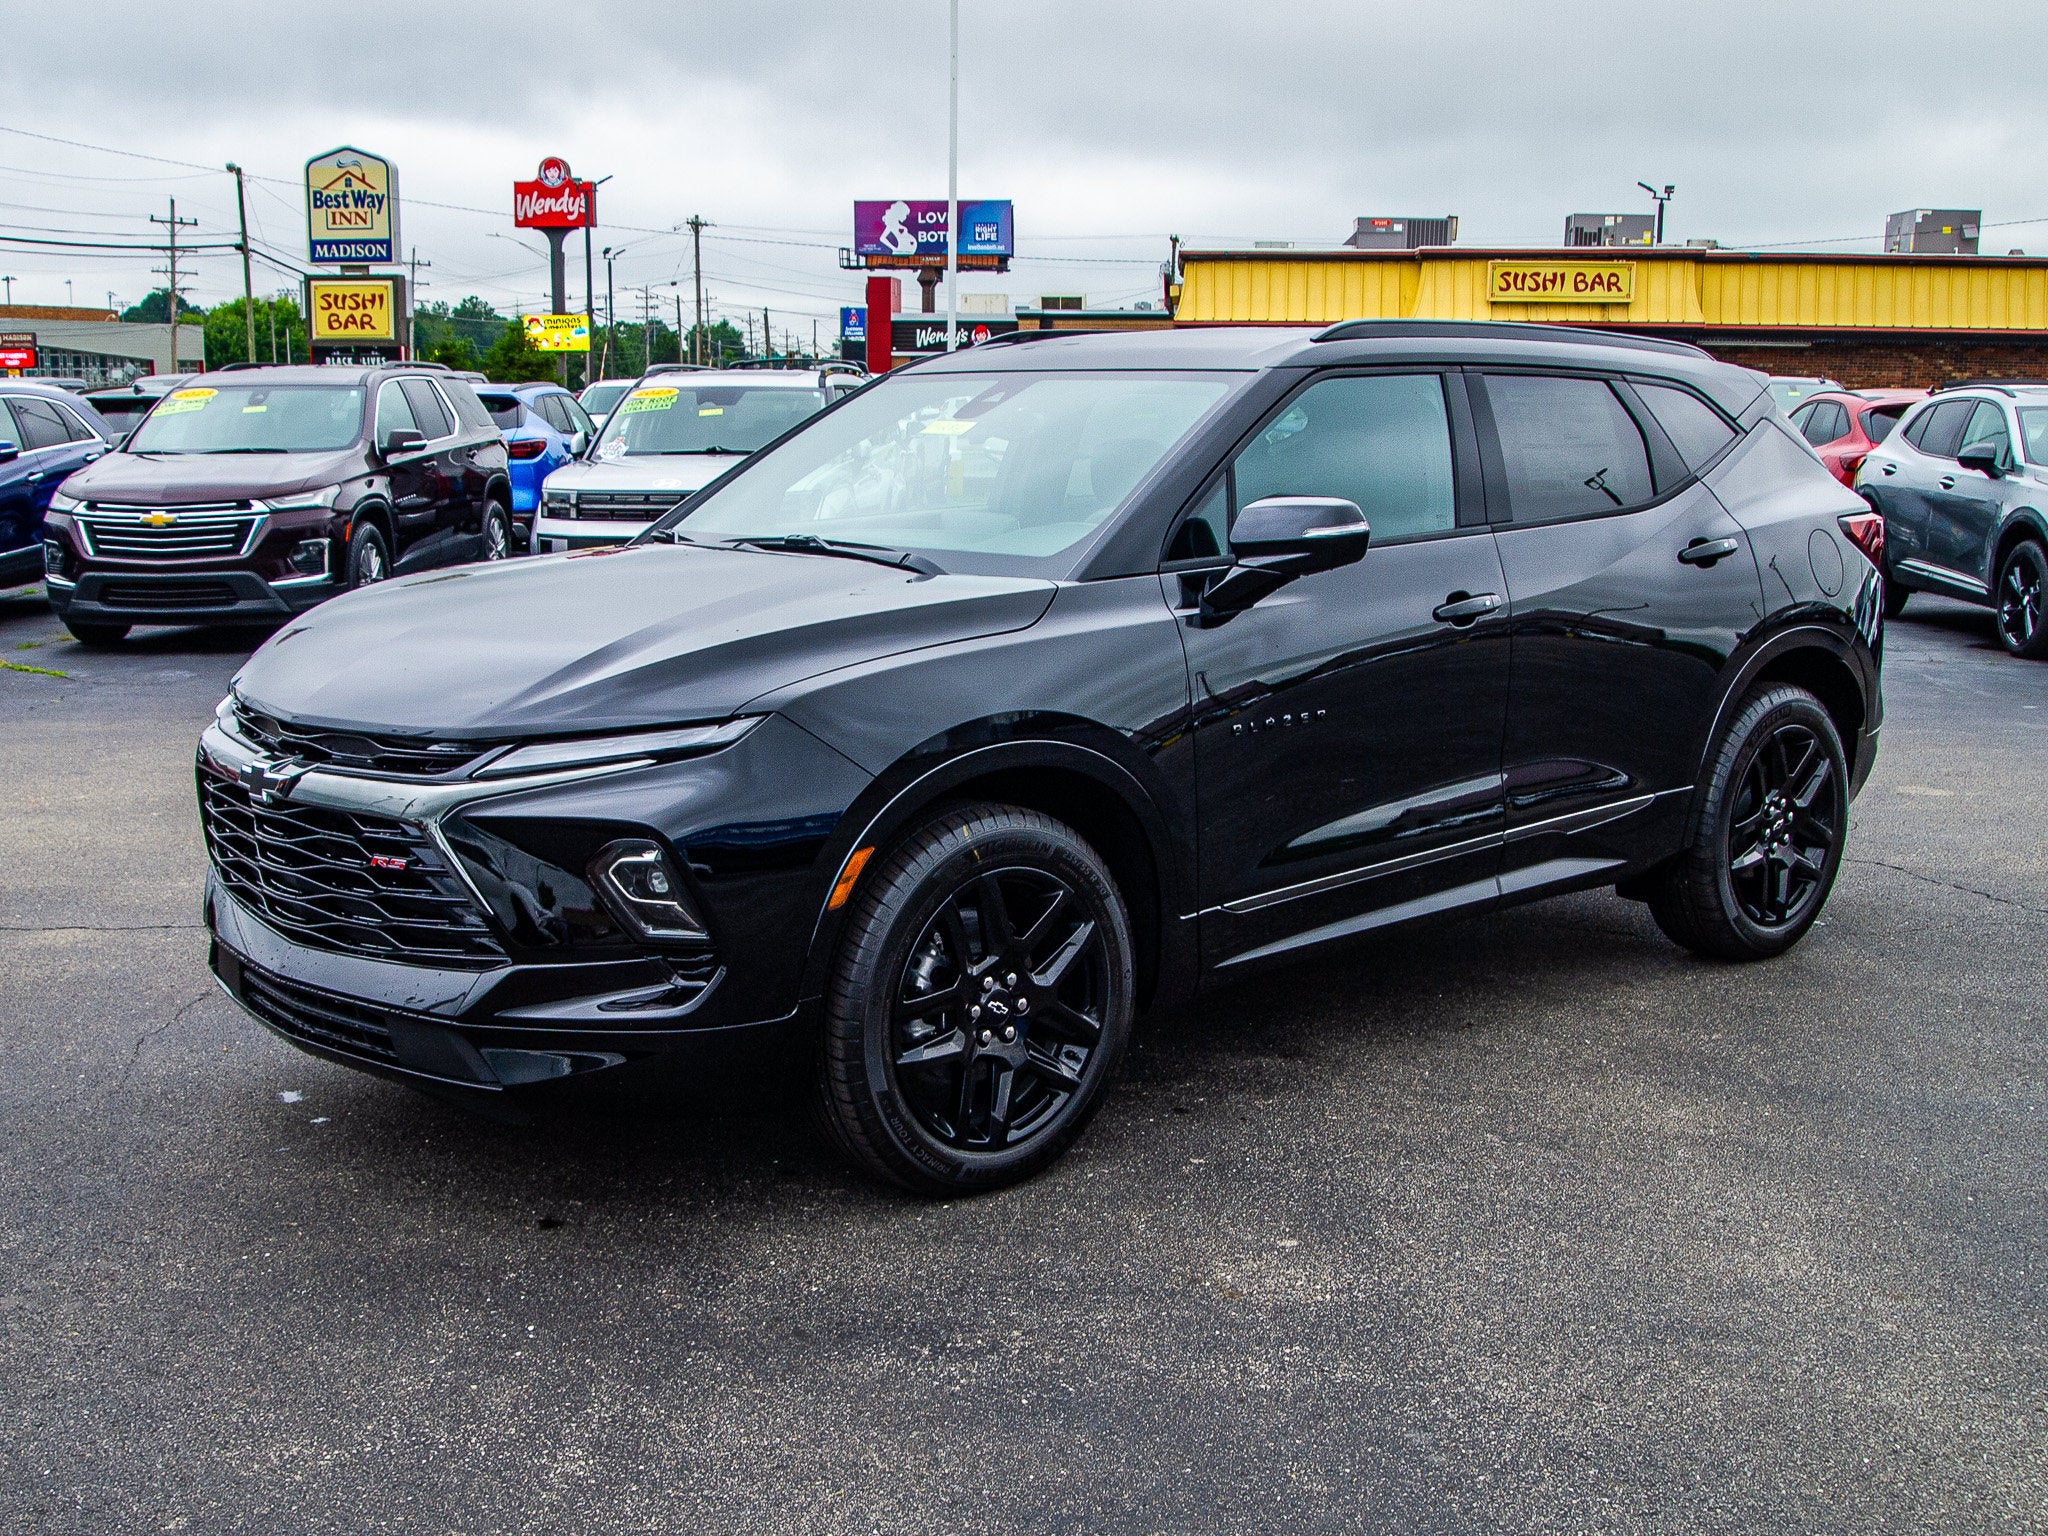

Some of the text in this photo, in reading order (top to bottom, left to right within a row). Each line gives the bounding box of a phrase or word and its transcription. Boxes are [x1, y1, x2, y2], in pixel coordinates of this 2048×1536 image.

[312, 189, 386, 215] Best Way
[330, 211, 369, 226] INN
[918, 211, 948, 224] LOV
[918, 231, 949, 243] BOT
[975, 232, 998, 241] LIFE
[314, 244, 387, 258] MADISON
[1498, 271, 1624, 293] SUSHI BAR
[320, 293, 384, 311] SUSHI
[327, 313, 377, 331] BAR
[371, 855, 407, 870] RS
